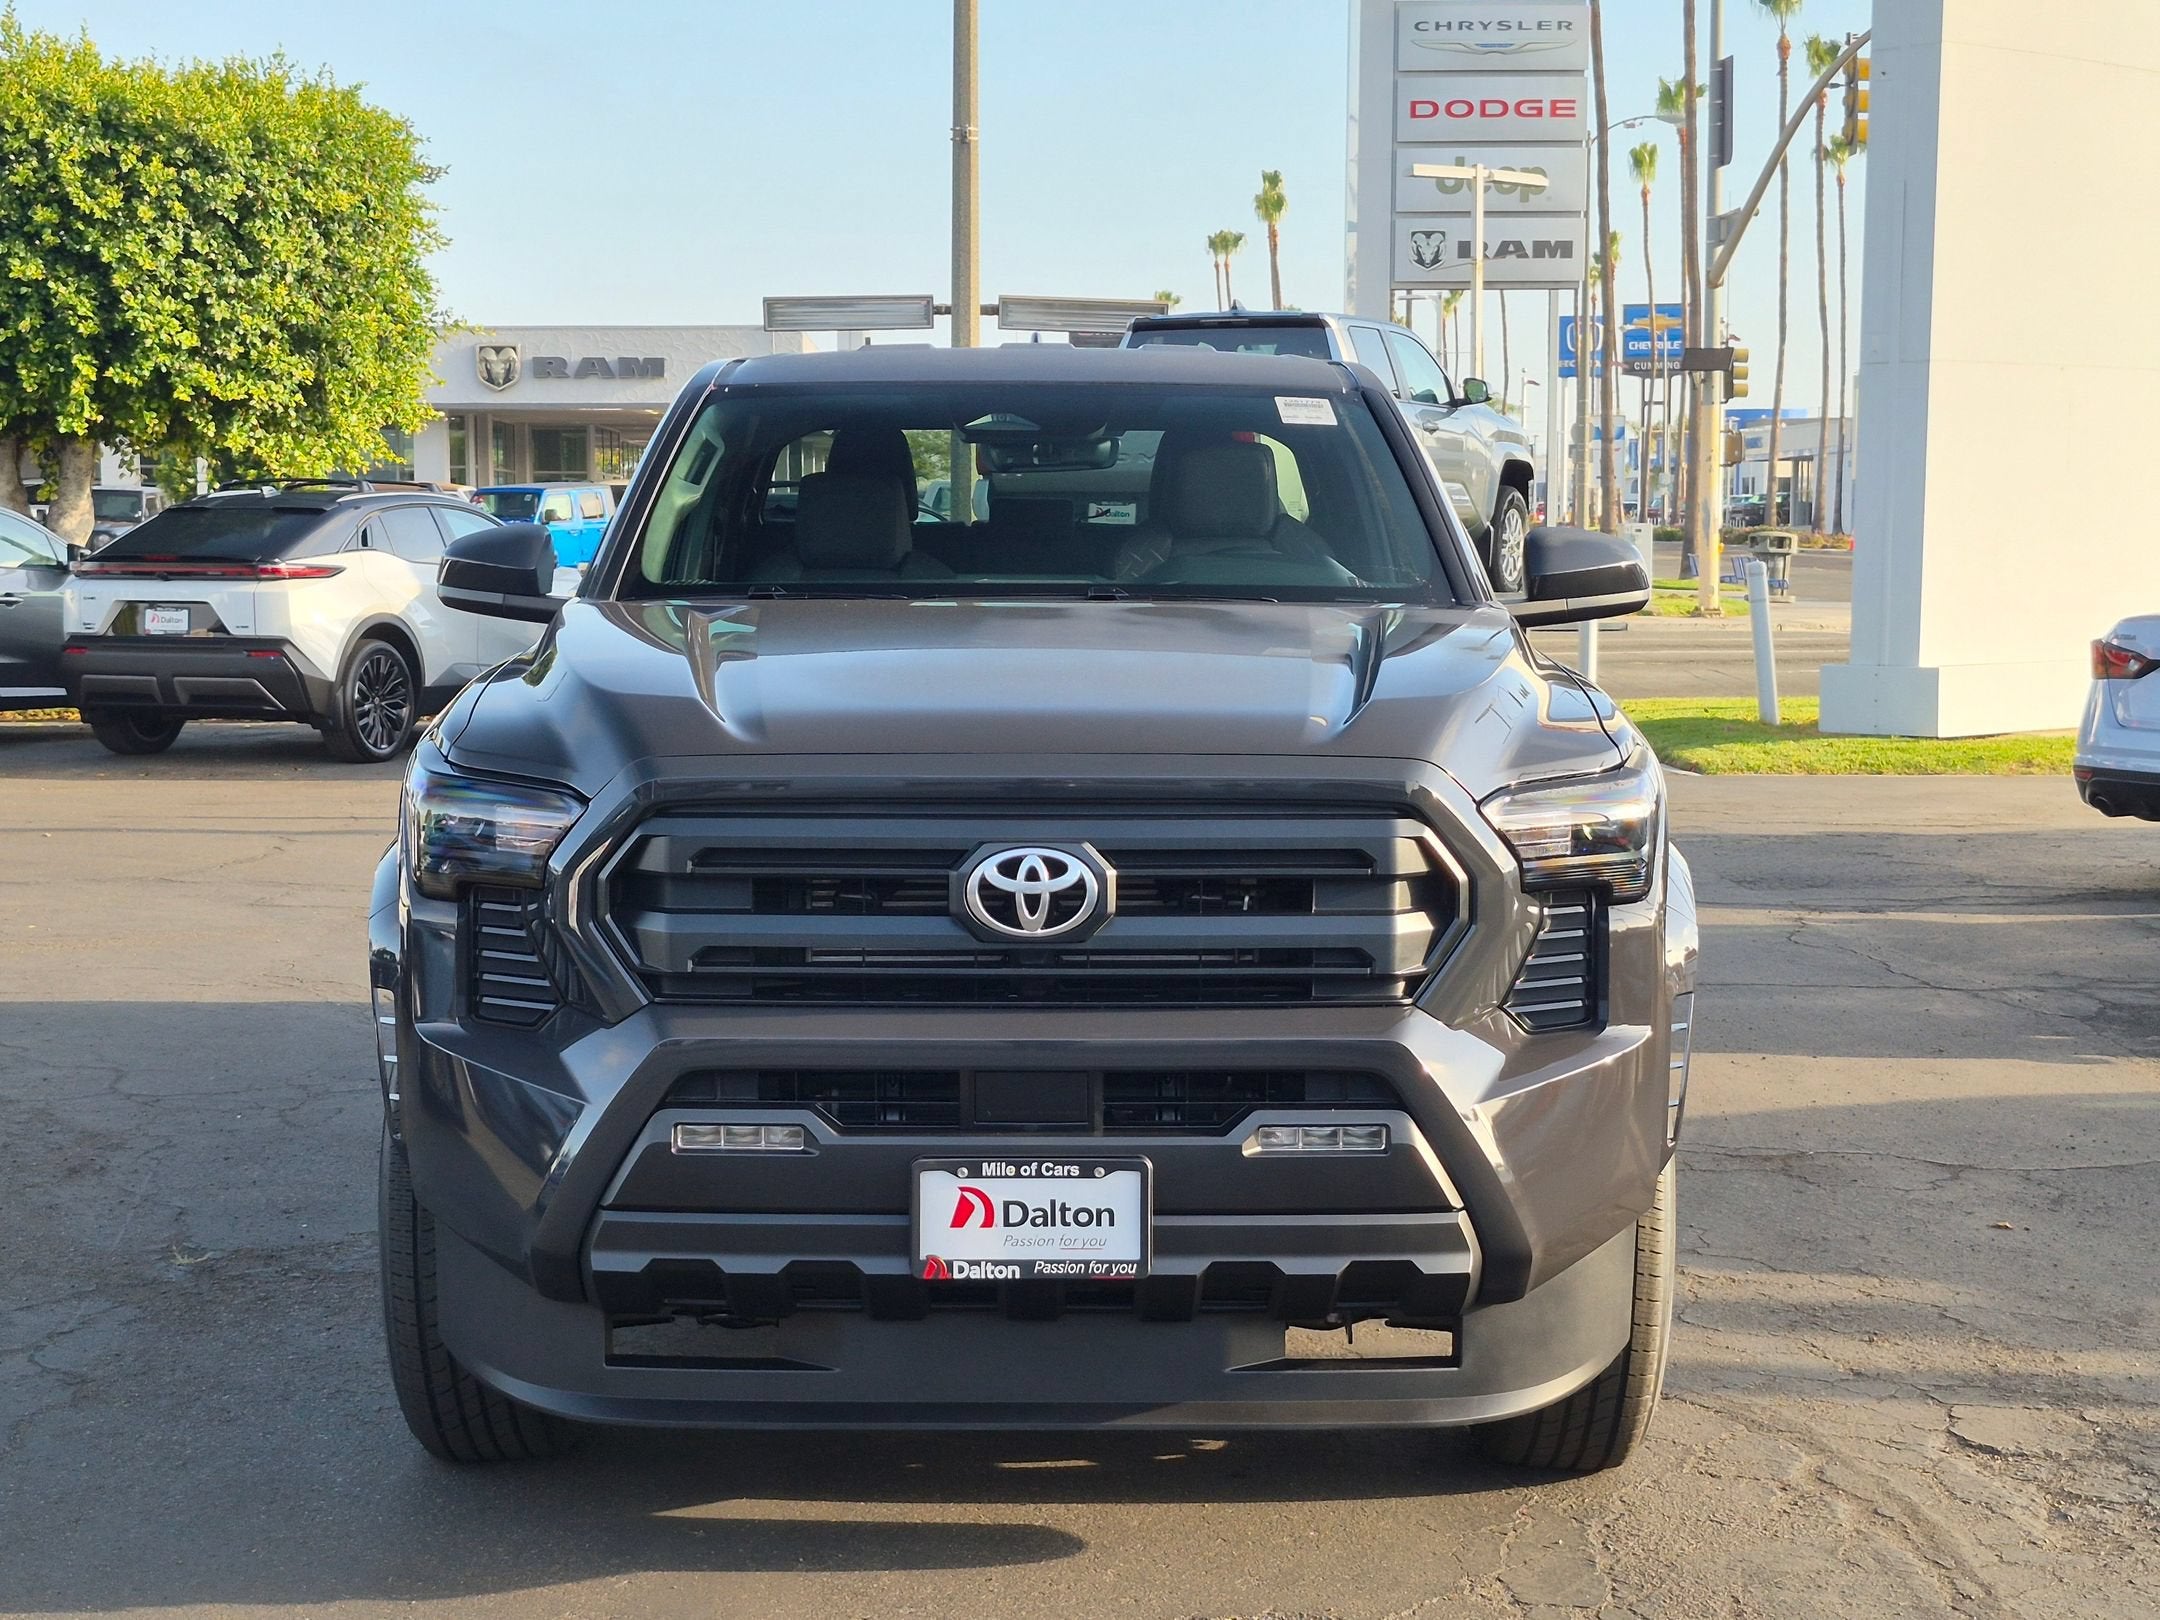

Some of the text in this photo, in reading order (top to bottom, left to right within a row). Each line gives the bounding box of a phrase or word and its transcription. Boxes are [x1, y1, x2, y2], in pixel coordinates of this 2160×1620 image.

[1414, 20, 1573, 31] CHRYSLER
[1410, 99, 1576, 119] DODGE
[1457, 240, 1573, 258] RAM
[532, 357, 665, 379] RAM
[982, 1162, 1080, 1177] Mile of Cars
[1003, 1199, 1115, 1228] Dalton
[1003, 1234, 1107, 1250] Passion for you
[953, 1260, 1020, 1279] Dalton
[1034, 1261, 1137, 1277] Passion for you
